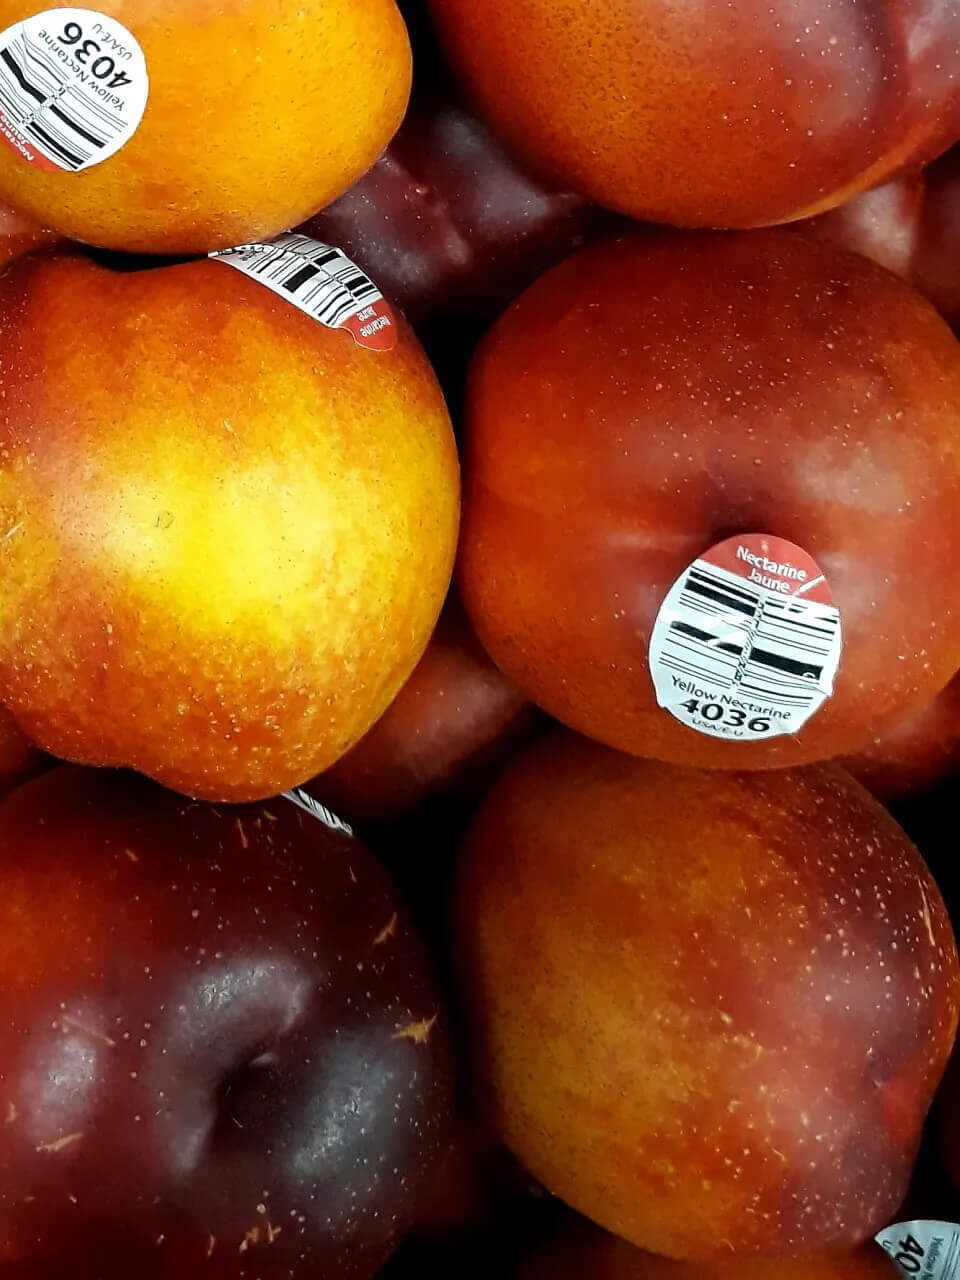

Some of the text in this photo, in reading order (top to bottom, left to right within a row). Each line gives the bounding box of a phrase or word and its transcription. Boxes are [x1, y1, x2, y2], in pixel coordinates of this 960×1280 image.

[37, 28, 127, 112] Yellow Nectarine
[56, 21, 133, 90] 4036
[0, 113, 31, 146] Jaune
[736, 544, 808, 582] Nectarine
[746, 567, 791, 594] Jaune
[671, 674, 792, 721] Yellow Nectarine
[678, 699, 772, 734] 4036
[895, 1233, 924, 1275] 40
